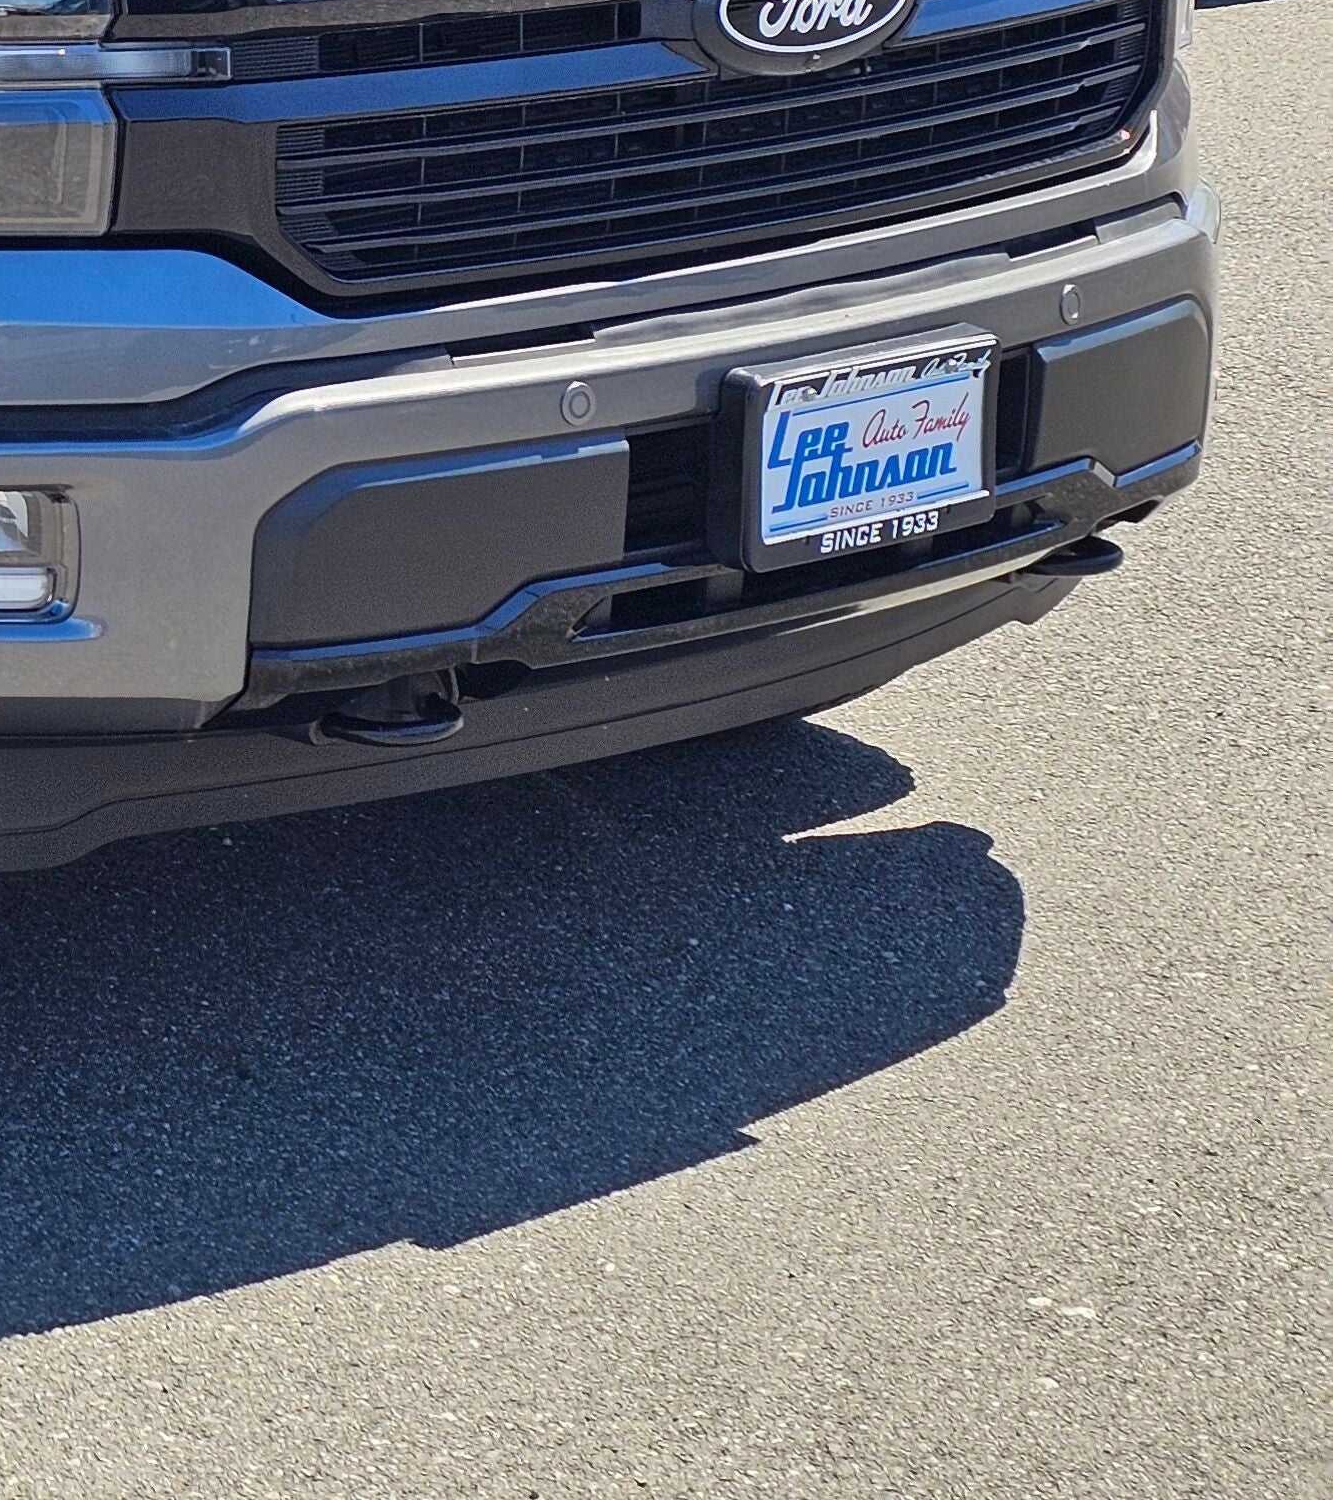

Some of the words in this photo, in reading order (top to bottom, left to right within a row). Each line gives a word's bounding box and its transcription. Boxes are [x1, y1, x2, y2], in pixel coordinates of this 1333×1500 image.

[820, 365, 917, 399] Johnson
[766, 410, 851, 470] Lee
[861, 408, 909, 448] Auto
[911, 392, 971, 441] Family
[771, 441, 958, 515] Johnson
[829, 499, 874, 519] SINCE
[880, 491, 915, 508] 1933
[820, 522, 883, 554] SINCE
[892, 511, 940, 540] 1933
